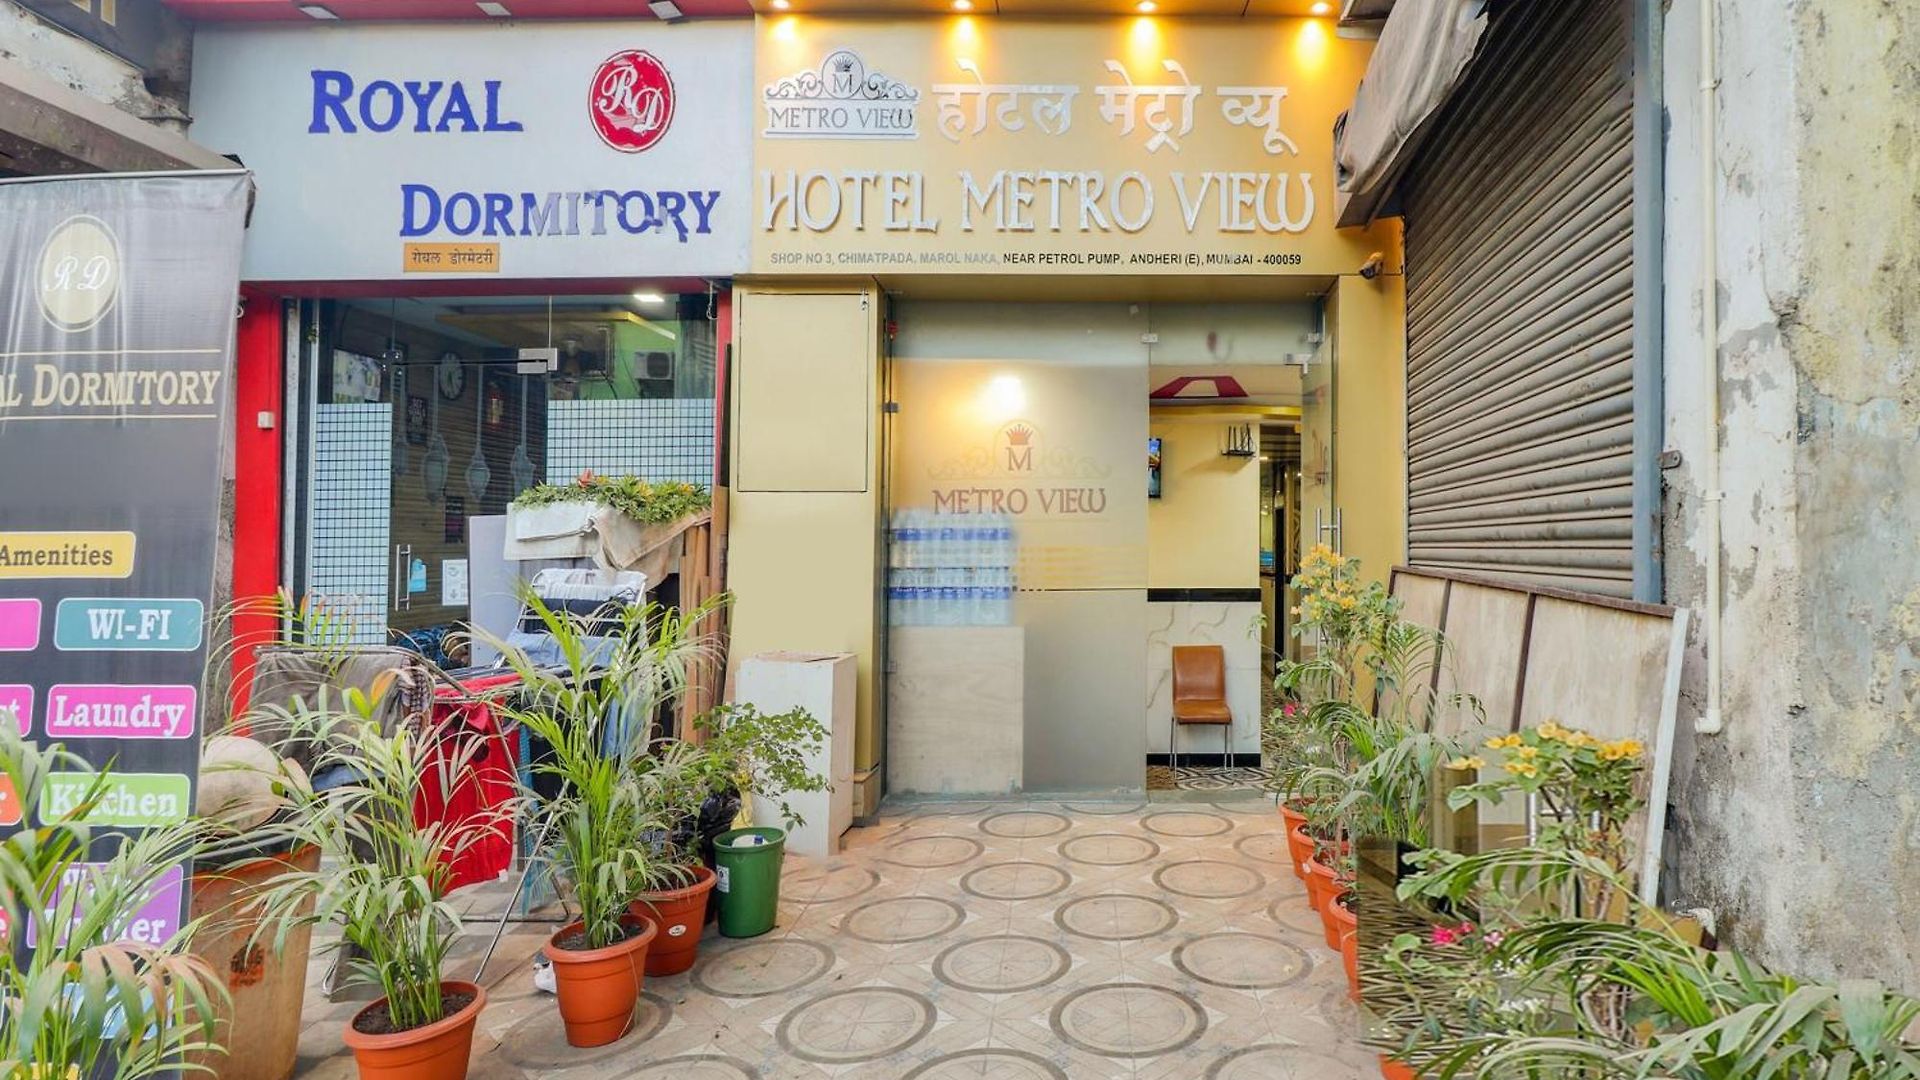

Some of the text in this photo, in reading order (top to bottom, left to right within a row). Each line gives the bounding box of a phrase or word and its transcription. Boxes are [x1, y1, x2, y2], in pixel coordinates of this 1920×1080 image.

[832, 74, 853, 93] M
[308, 69, 523, 133] ROYAL
[931, 57, 1299, 157] होटल मेट्रो व्यू
[770, 107, 913, 129] METRO VIEW
[399, 184, 721, 242] DORMITORY
[761, 167, 1316, 233] HOTEL METRO VIEW
[770, 252, 803, 264] SHOP
[806, 252, 823, 264] NO
[920, 252, 961, 264] MAROL
[1003, 253, 1035, 264] NEAR
[1038, 253, 1084, 264] PETROL
[1130, 253, 1182, 265] ANDHERI
[32, 363, 220, 407] DORMITORY
[1005, 447, 1033, 472] M
[932, 486, 1107, 515] METRO VIEW
[0, 543, 113, 567] Amenities
[87, 608, 172, 640] WI-FI
[53, 694, 186, 738] Laundry
